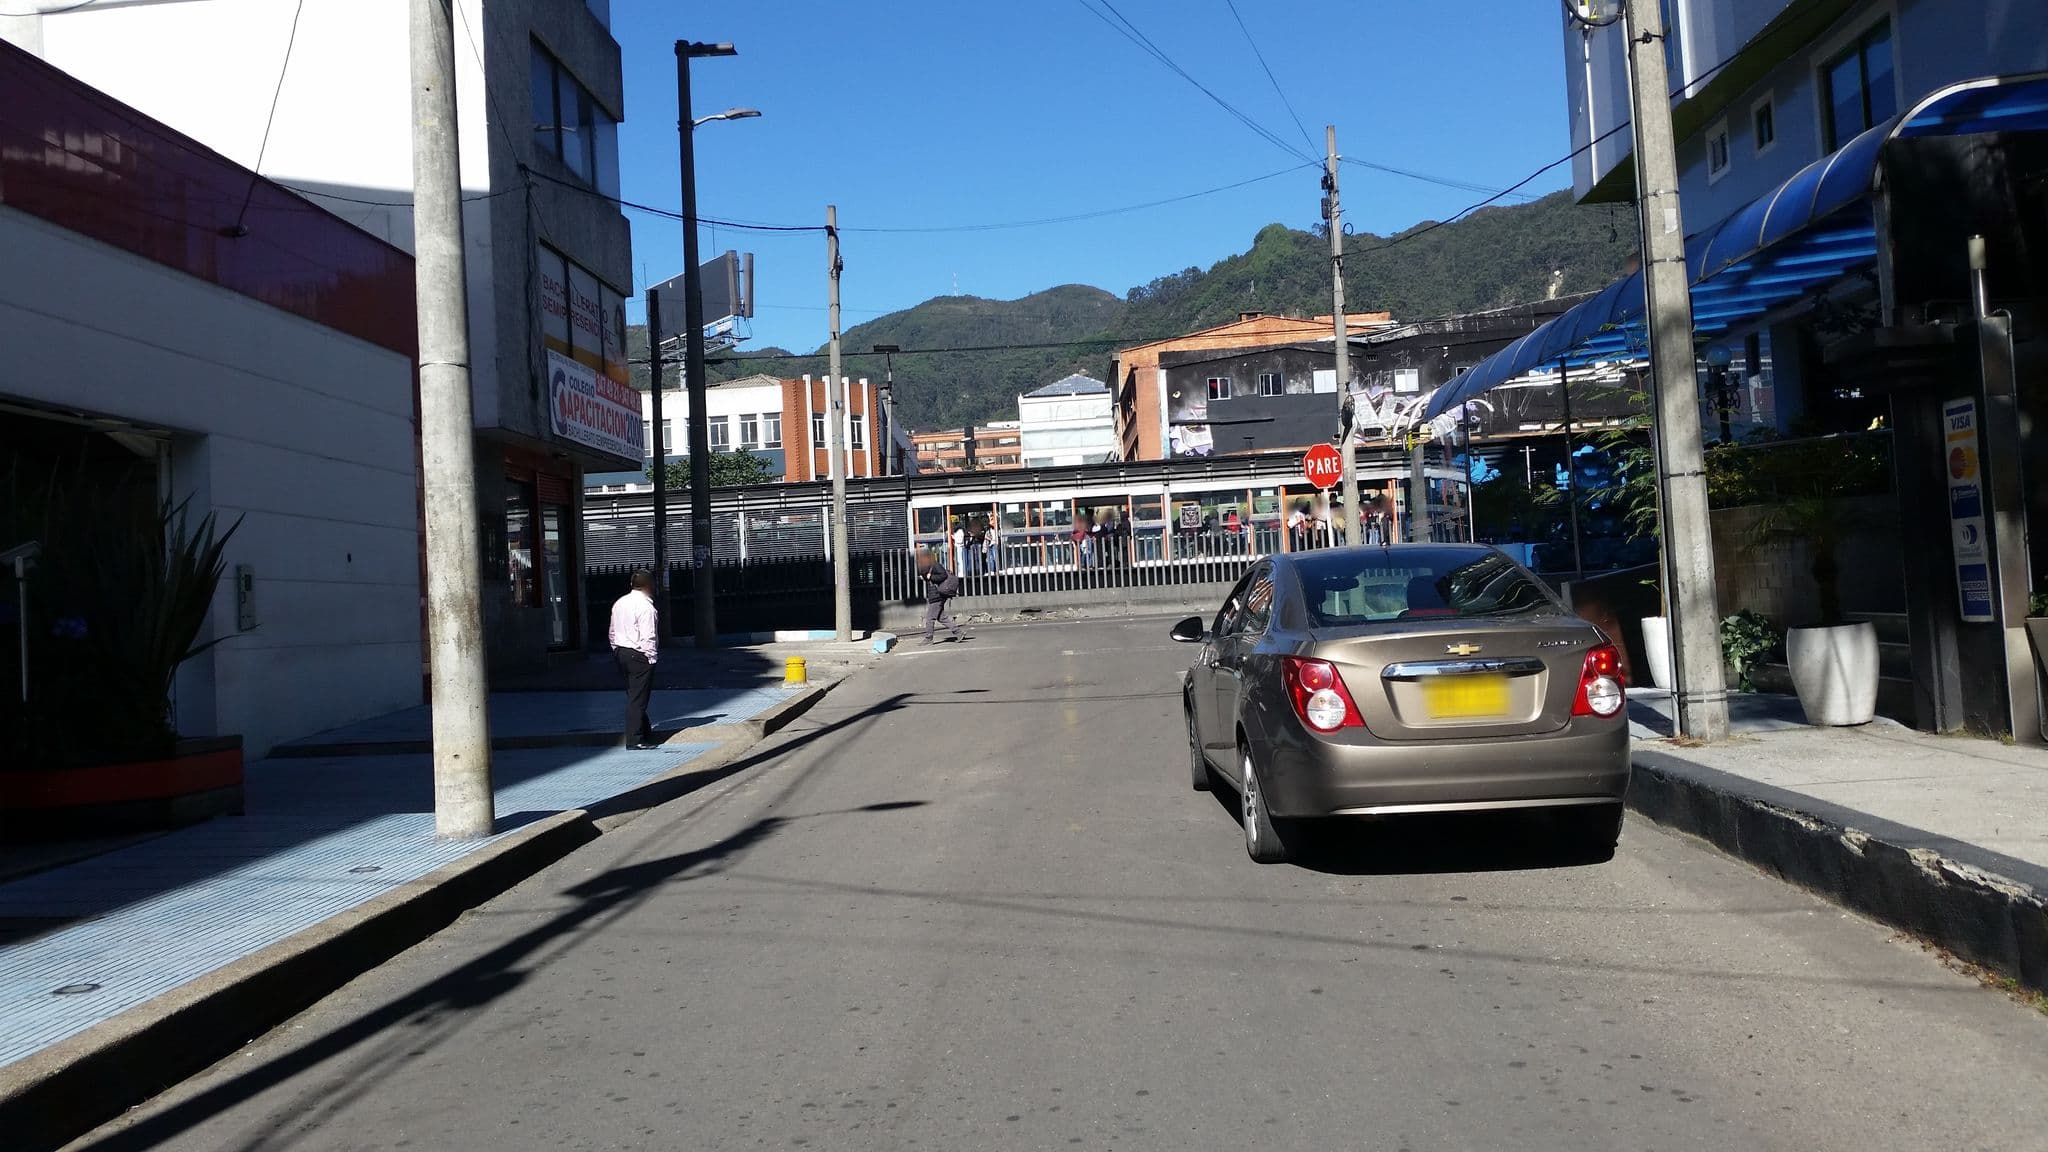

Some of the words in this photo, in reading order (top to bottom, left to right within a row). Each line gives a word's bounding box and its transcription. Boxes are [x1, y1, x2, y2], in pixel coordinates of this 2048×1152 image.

[569, 376, 595, 398] COLEGIO
[1951, 415, 1970, 430] VISA
[1307, 456, 1339, 475] PARE
